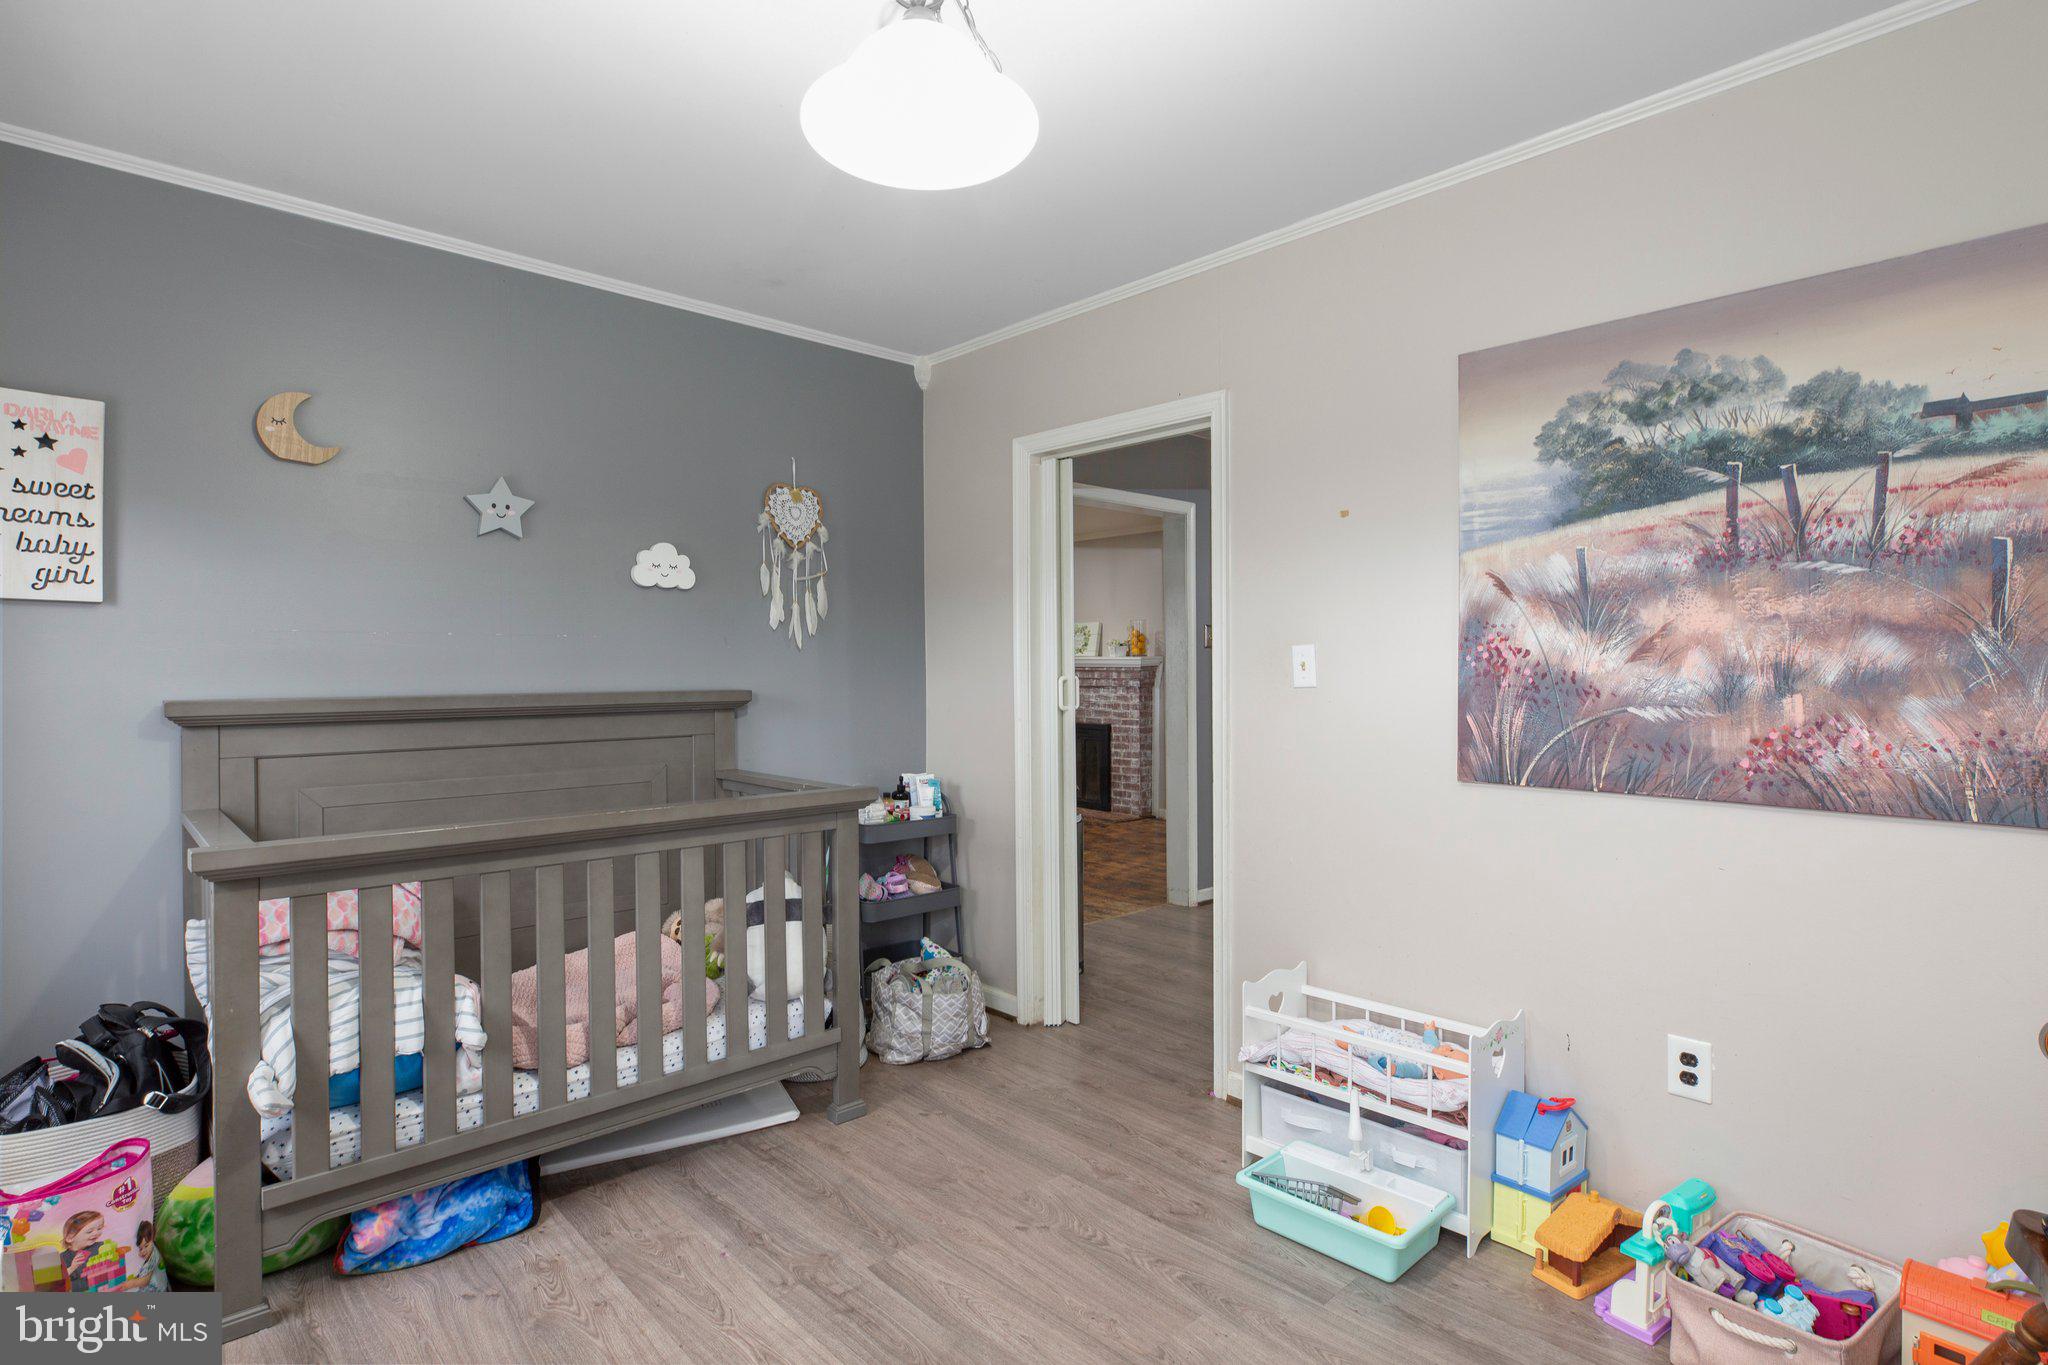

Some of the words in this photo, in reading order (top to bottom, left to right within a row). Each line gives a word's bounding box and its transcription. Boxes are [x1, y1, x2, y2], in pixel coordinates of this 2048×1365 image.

[12, 478, 95, 500] sweet
[16, 531, 95, 565] baby
[31, 564, 95, 591] girl
[118, 1176, 132, 1195] #1
